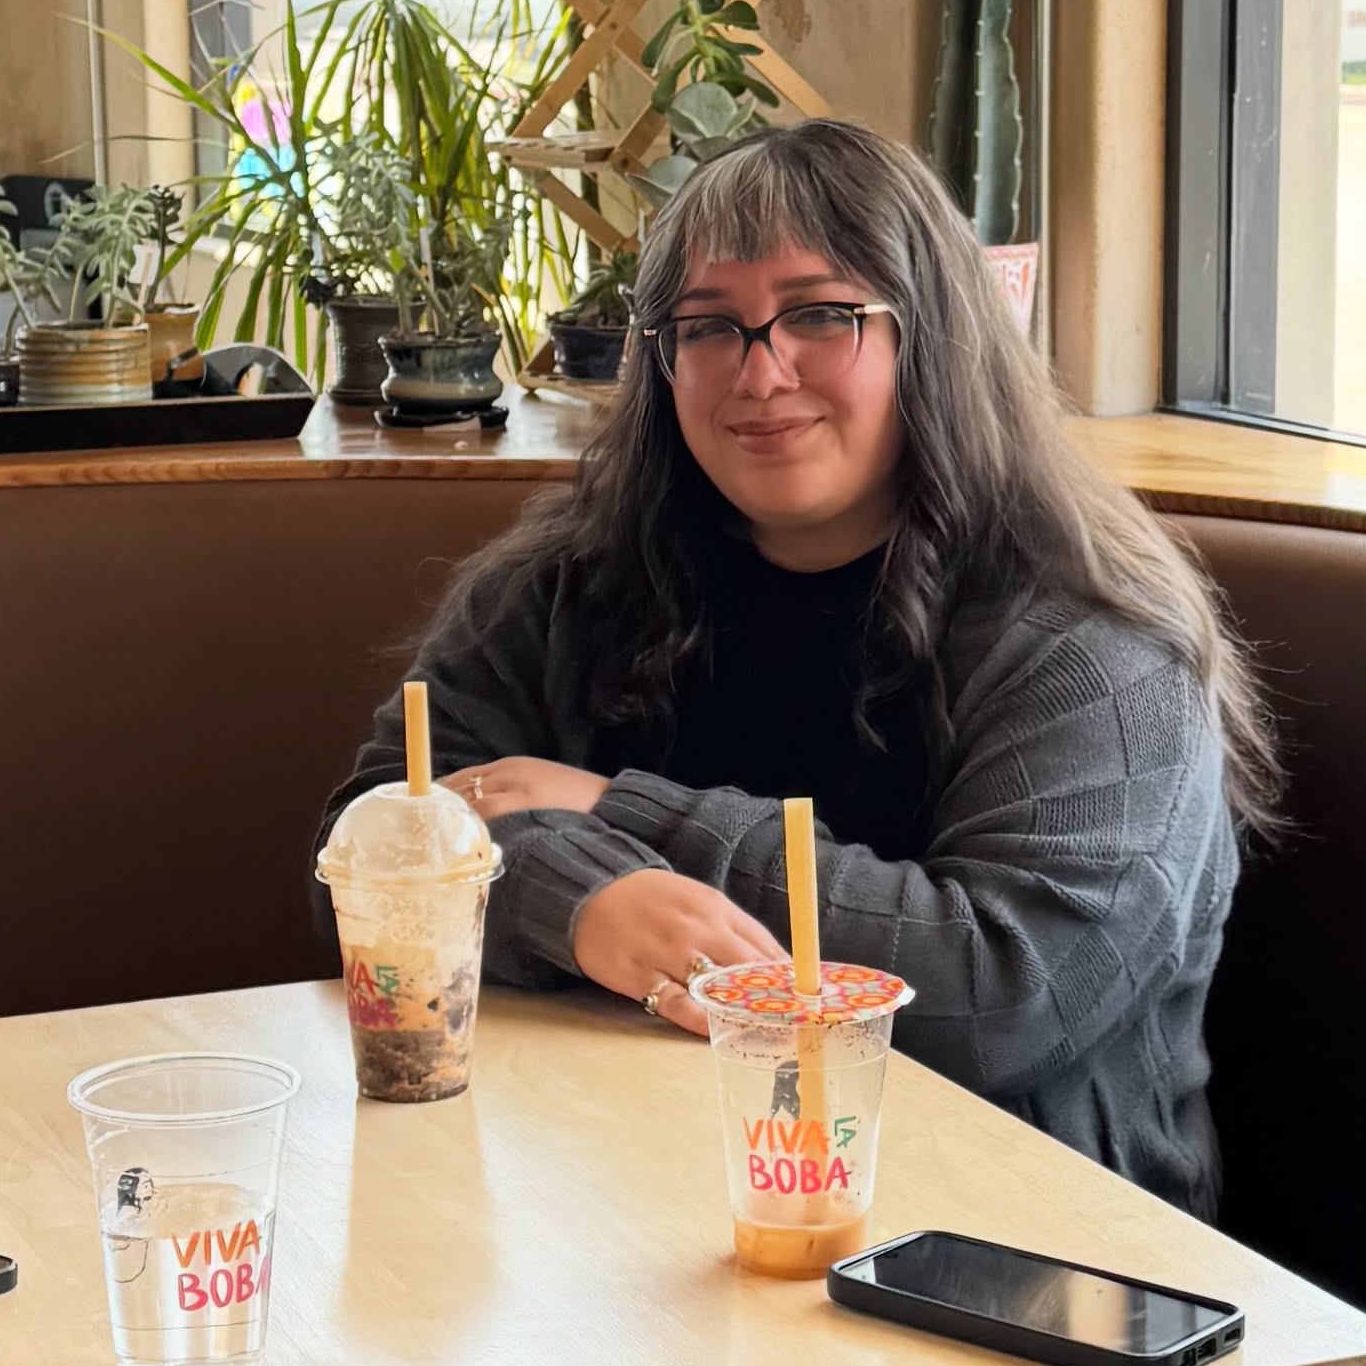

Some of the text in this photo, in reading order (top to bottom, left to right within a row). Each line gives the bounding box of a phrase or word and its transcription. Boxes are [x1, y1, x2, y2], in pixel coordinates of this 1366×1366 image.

[742, 1115, 830, 1156] VIVA
[749, 1154, 853, 1195] BOBA
[171, 1219, 262, 1269] VIVA
